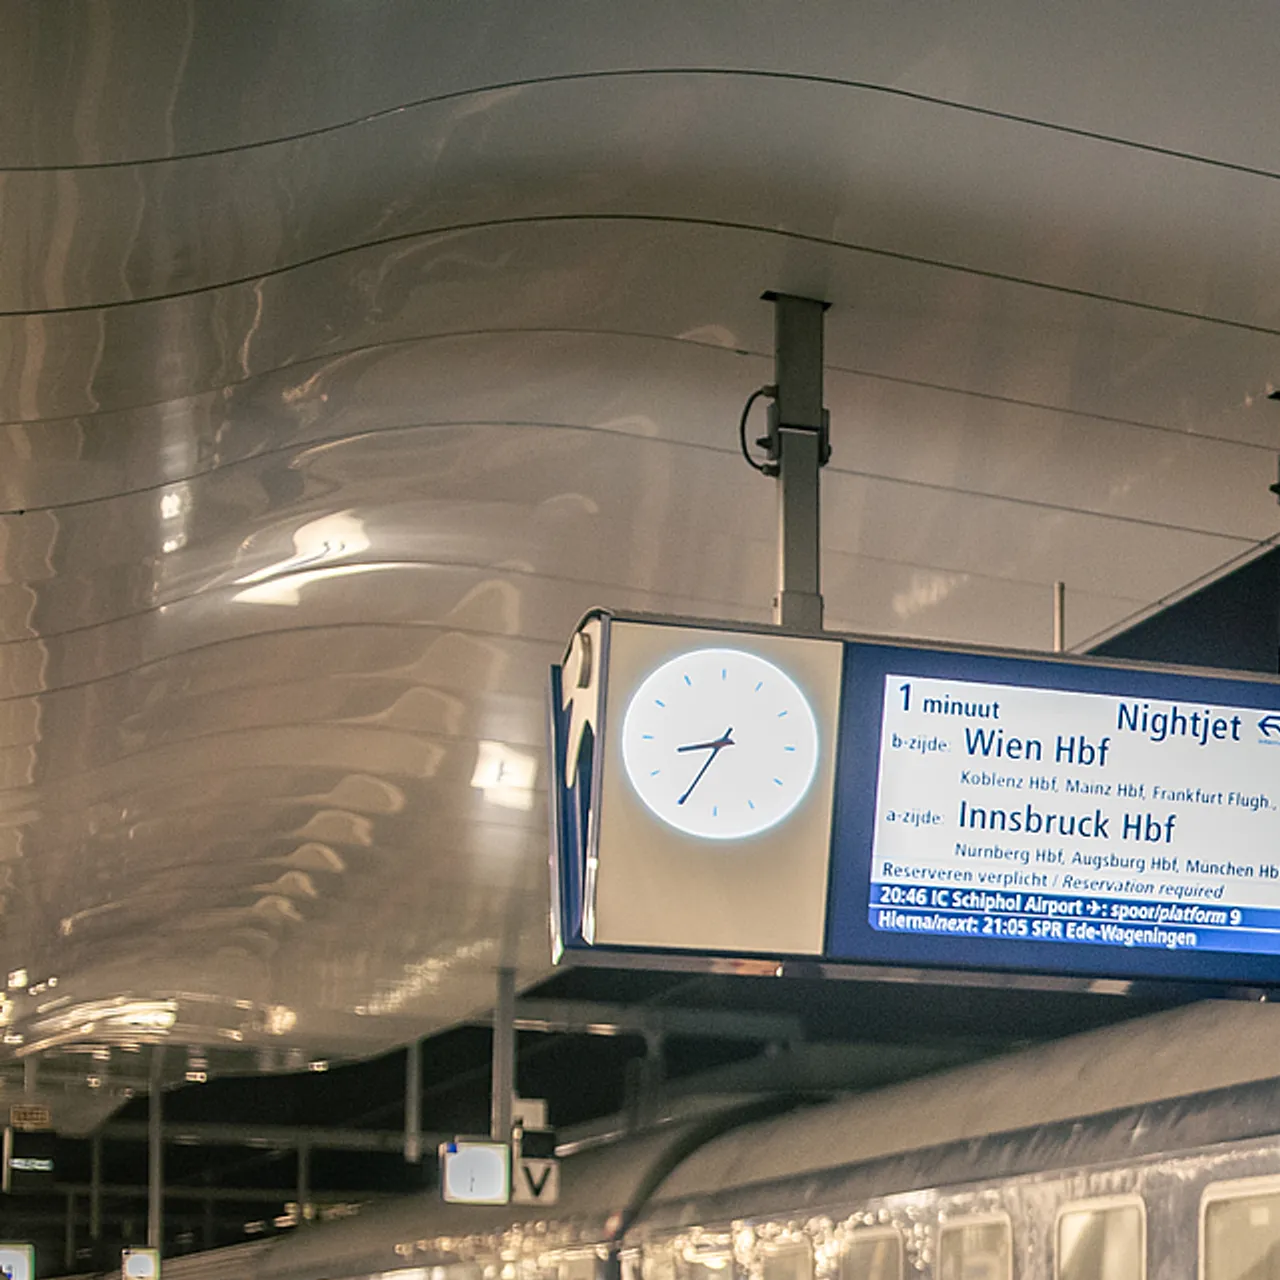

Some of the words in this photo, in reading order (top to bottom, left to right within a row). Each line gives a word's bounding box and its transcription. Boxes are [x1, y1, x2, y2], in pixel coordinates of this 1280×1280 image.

[899, 683, 911, 711] 1
[923, 694, 1000, 719] minuut
[1117, 702, 1242, 746] Nightjet
[892, 732, 951, 754] b-zijde:
[964, 728, 1041, 761] Wien
[1055, 735, 1111, 766] Hbf
[960, 770, 1024, 789] Koblenz
[1029, 776, 1060, 793] Hbf,
[1065, 779, 1112, 796] Mainz
[1117, 783, 1147, 801] Hbf,
[1152, 786, 1223, 806] Frankfurt
[959, 800, 1110, 839] Innsbruck
[1122, 813, 1177, 844] Hbf
[1035, 846, 1065, 866] Hbf,
[1072, 851, 1146, 874] Augsburg
[1151, 857, 1180, 874] Hbf,
[882, 862, 973, 882] Reserveren
[978, 868, 1048, 889] verplicht
[1061, 874, 1155, 896] Reservation
[1158, 883, 1226, 901] required
[880, 886, 927, 905] 20:46
[932, 890, 949, 907] IC
[952, 891, 1021, 913] Schiphol
[1024, 896, 1083, 917] Airport
[1110, 903, 1228, 925] spoor/platform
[1229, 908, 1242, 926] 9
[879, 910, 978, 934] Hierna/next:
[982, 917, 1028, 935] 21:05
[1032, 920, 1062, 938] SPR
[1065, 923, 1197, 948] Ede-Wageningen
[522, 1165, 552, 1197] V
